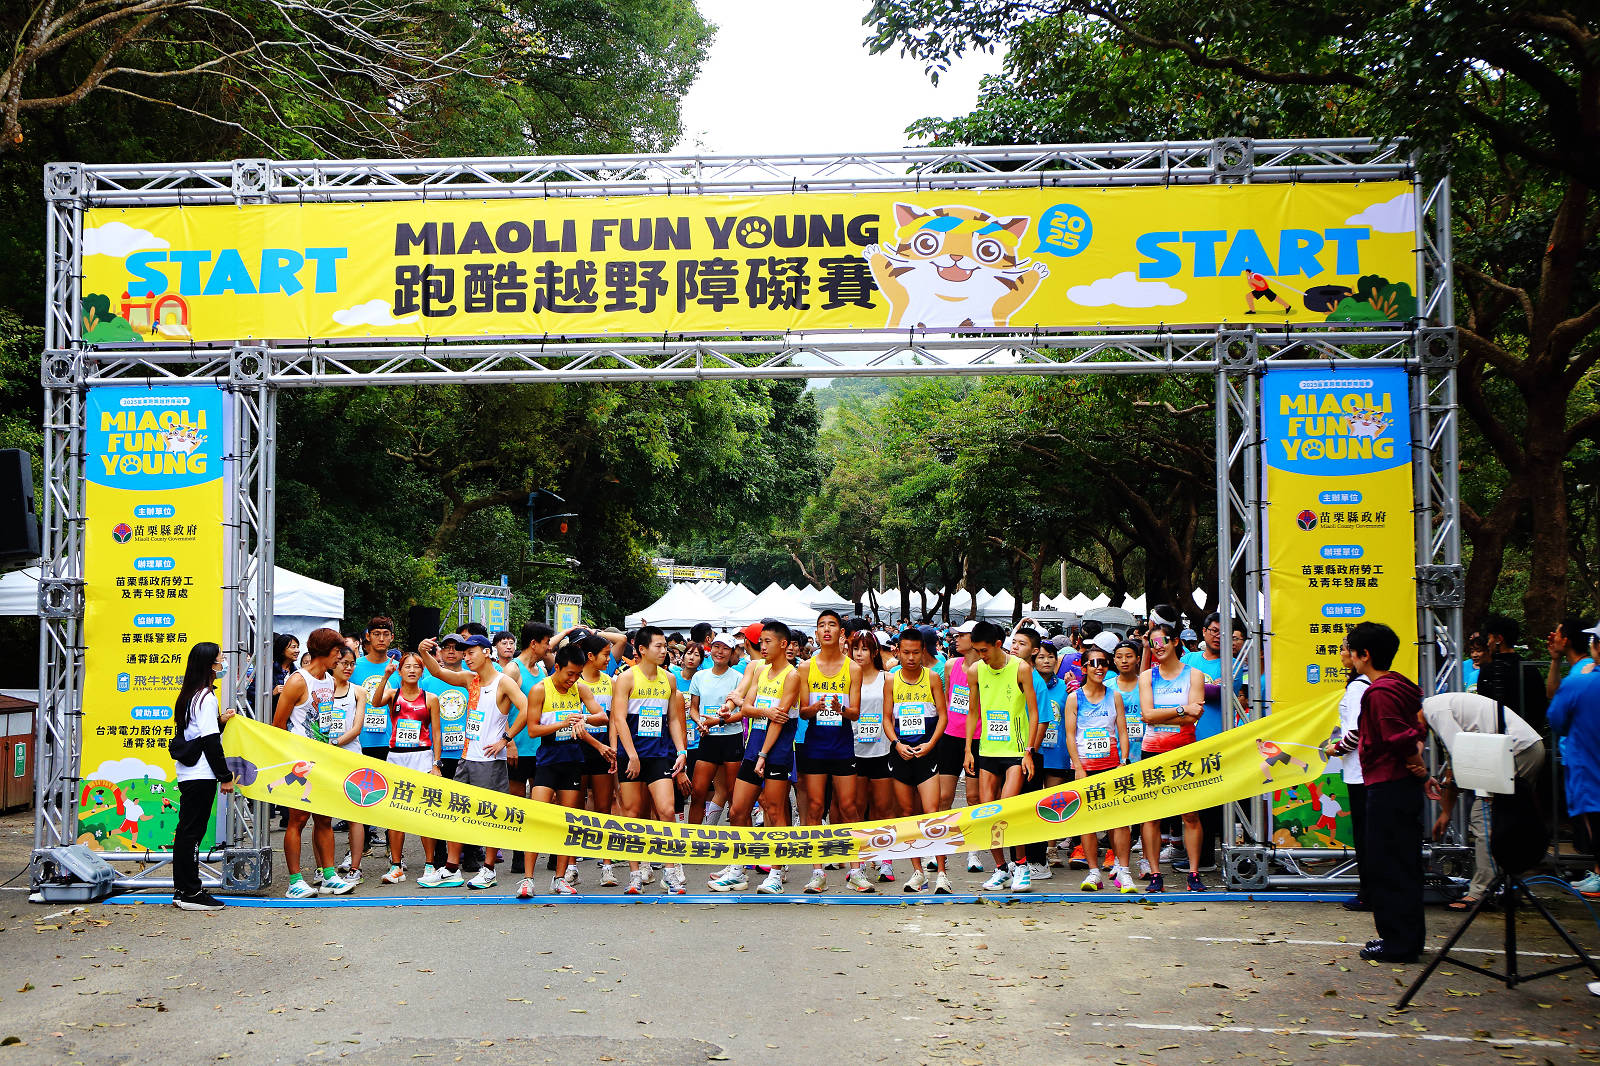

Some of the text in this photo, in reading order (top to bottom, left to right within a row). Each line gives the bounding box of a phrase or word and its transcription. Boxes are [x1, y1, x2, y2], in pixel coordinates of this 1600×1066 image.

[1049, 210, 1085, 231] 20
[394, 214, 881, 257] MIAOLI FUN YOUNG
[1045, 230, 1081, 250] 25
[1135, 227, 1371, 280] START
[125, 247, 348, 297] START
[393, 254, 881, 318] 跑酷越野障礙賽
[1279, 393, 1393, 416] MIAOLI
[100, 410, 207, 432] MIAOLI
[1287, 416, 1350, 437] FUN
[107, 432, 166, 453] FUN
[1280, 437, 1395, 461] YOUNG
[100, 453, 208, 476] YOUNG
[137, 507, 172, 517] 主辦單位
[1319, 511, 1387, 524] 苗栗縣政府
[133, 524, 198, 537] 苗栗縣政府
[137, 559, 172, 569] 辦理單位
[1301, 564, 1384, 576] 苗栗縣政府勞工
[115, 576, 194, 587] 苗栗縣政府勞工
[1308, 577, 1379, 588] 及青年發展處
[121, 588, 188, 599] 及青年發展處
[137, 616, 171, 626] 協辦單位
[121, 633, 188, 644] 苗栗縣警察局
[126, 654, 182, 665] 通霄鎮公所
[366, 717, 385, 725] 2225
[640, 720, 660, 728] 2056
[902, 718, 922, 727] 2059
[860, 726, 880, 734] 2187
[989, 724, 1008, 732] 2224
[398, 731, 418, 740] 2185
[444, 734, 464, 743] 2012
[1087, 741, 1108, 750] 2180
[1083, 750, 1223, 804] 苗栗縣政府
[1087, 774, 1224, 812] Miaoli County Government
[391, 779, 527, 825] 苗栗縣政府
[389, 800, 523, 833] Miaoli County Government
[564, 811, 853, 841] MIAOLI FUN YOUNG
[564, 824, 855, 859] 跑酷越野障礙賽
